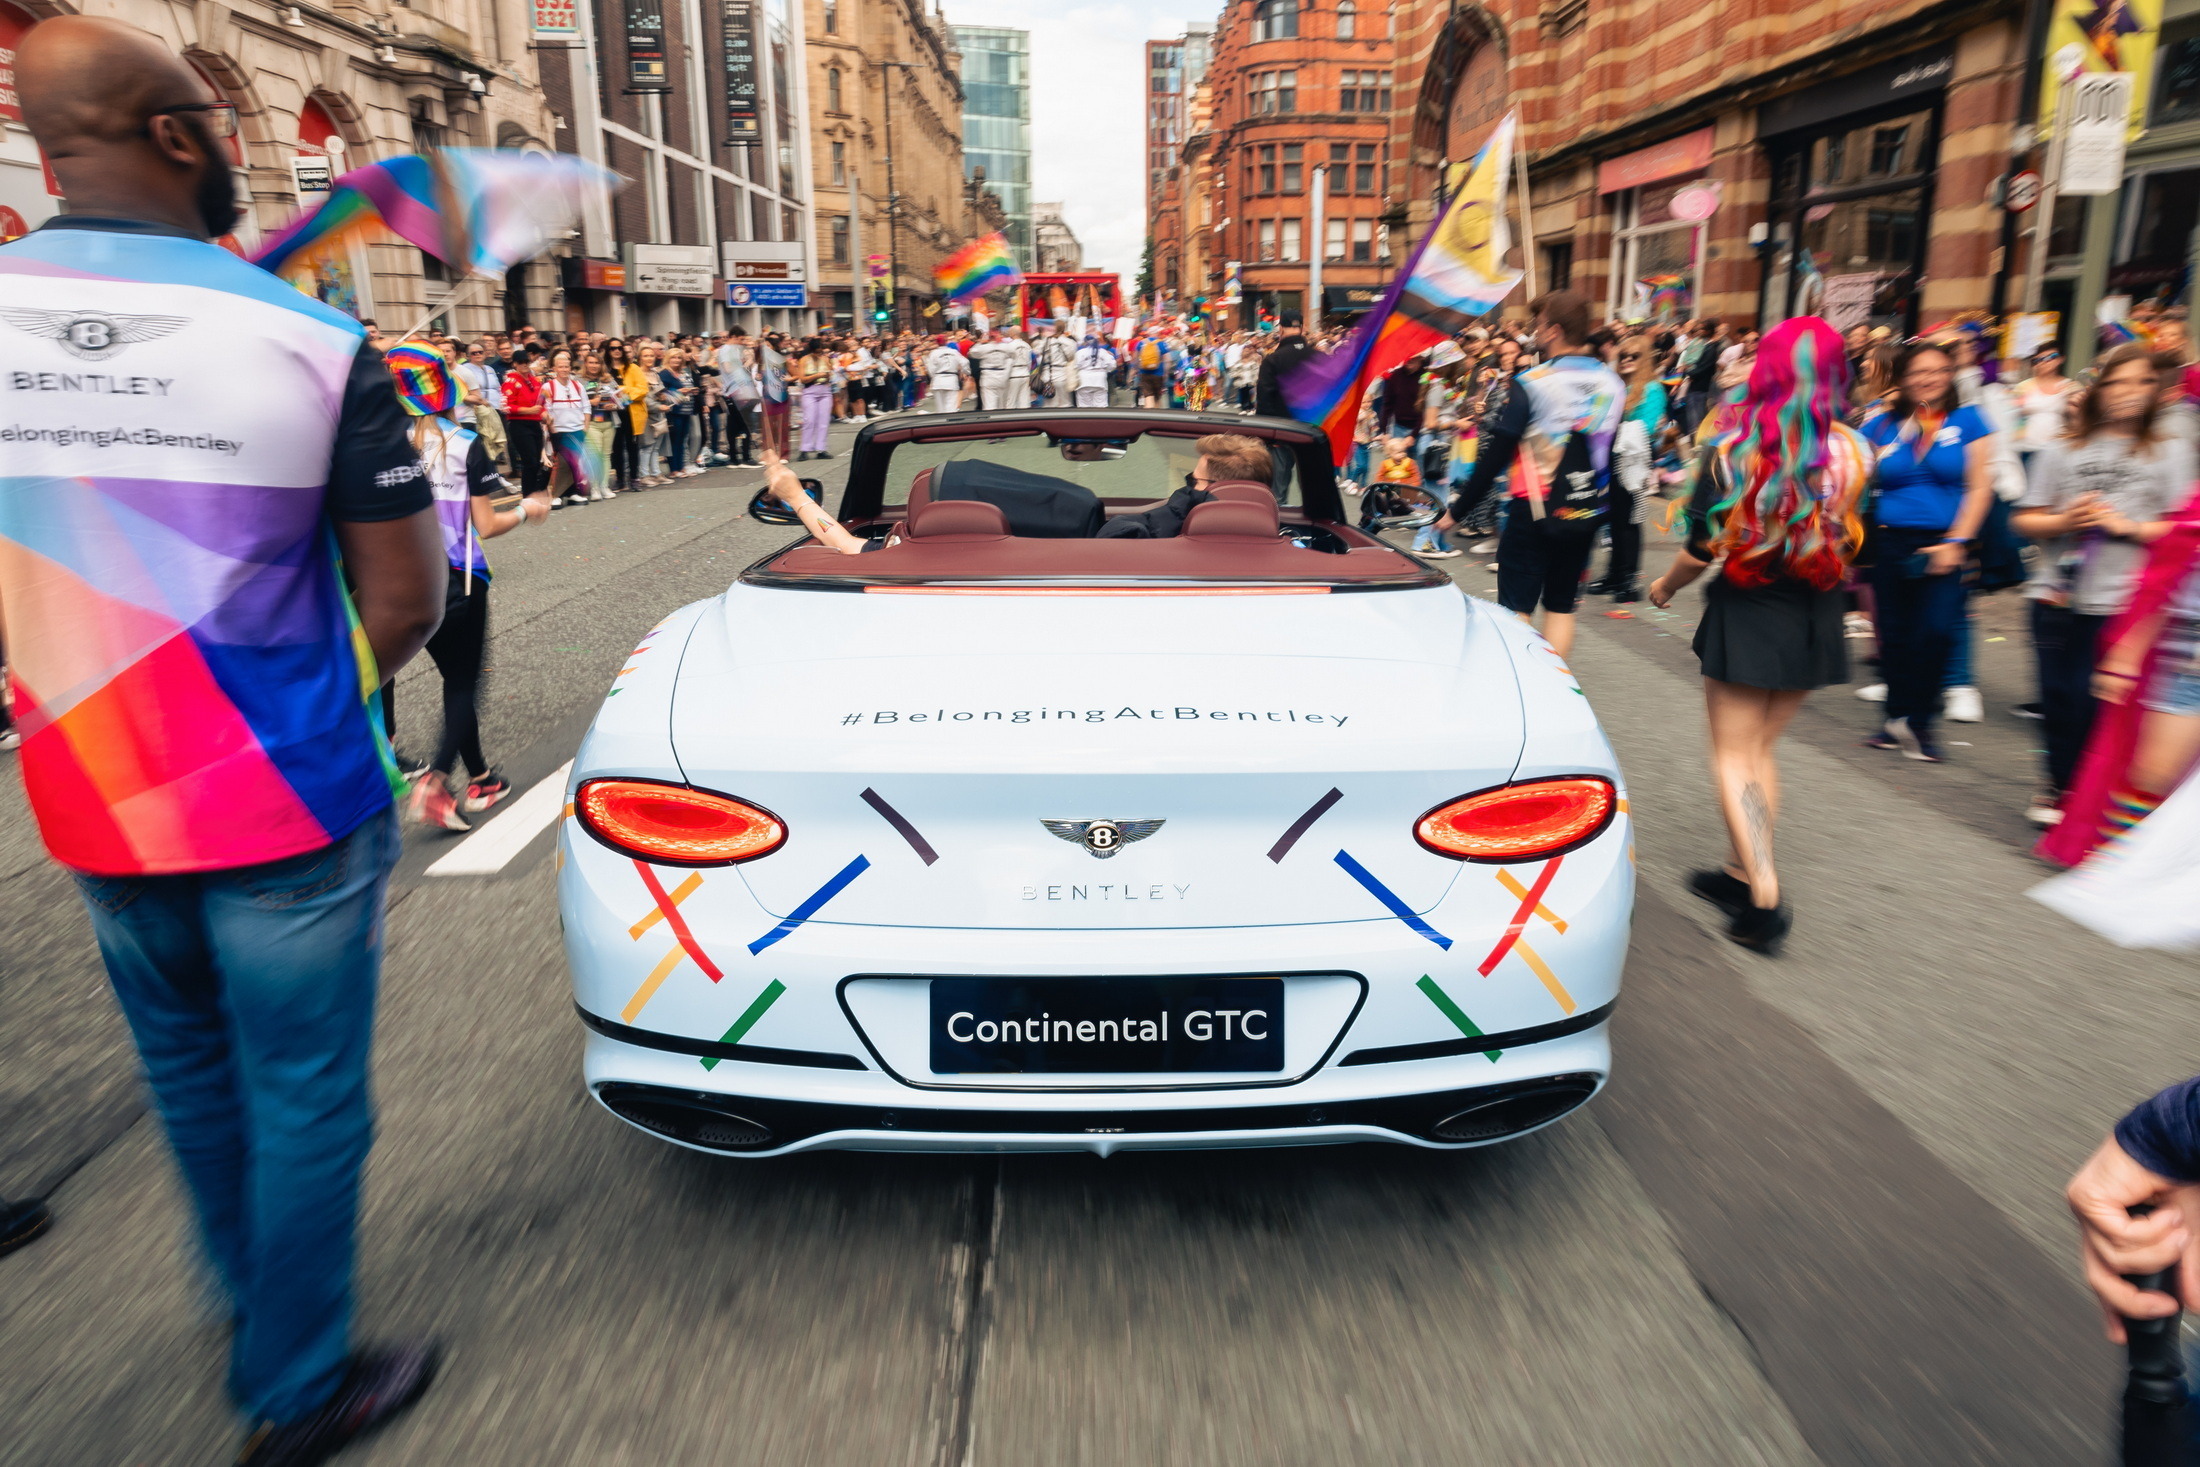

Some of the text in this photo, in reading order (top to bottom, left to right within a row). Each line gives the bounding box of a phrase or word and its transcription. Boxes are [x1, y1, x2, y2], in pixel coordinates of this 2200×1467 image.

[536, 10, 576, 27] 8321
[300, 181, 331, 190] Bus Stop
[11, 371, 175, 396] BENTLEY
[840, 706, 1349, 728] #BelongingAtBentley
[1021, 883, 1191, 901] BENTLEY
[947, 1010, 1268, 1043] Continental GTC
